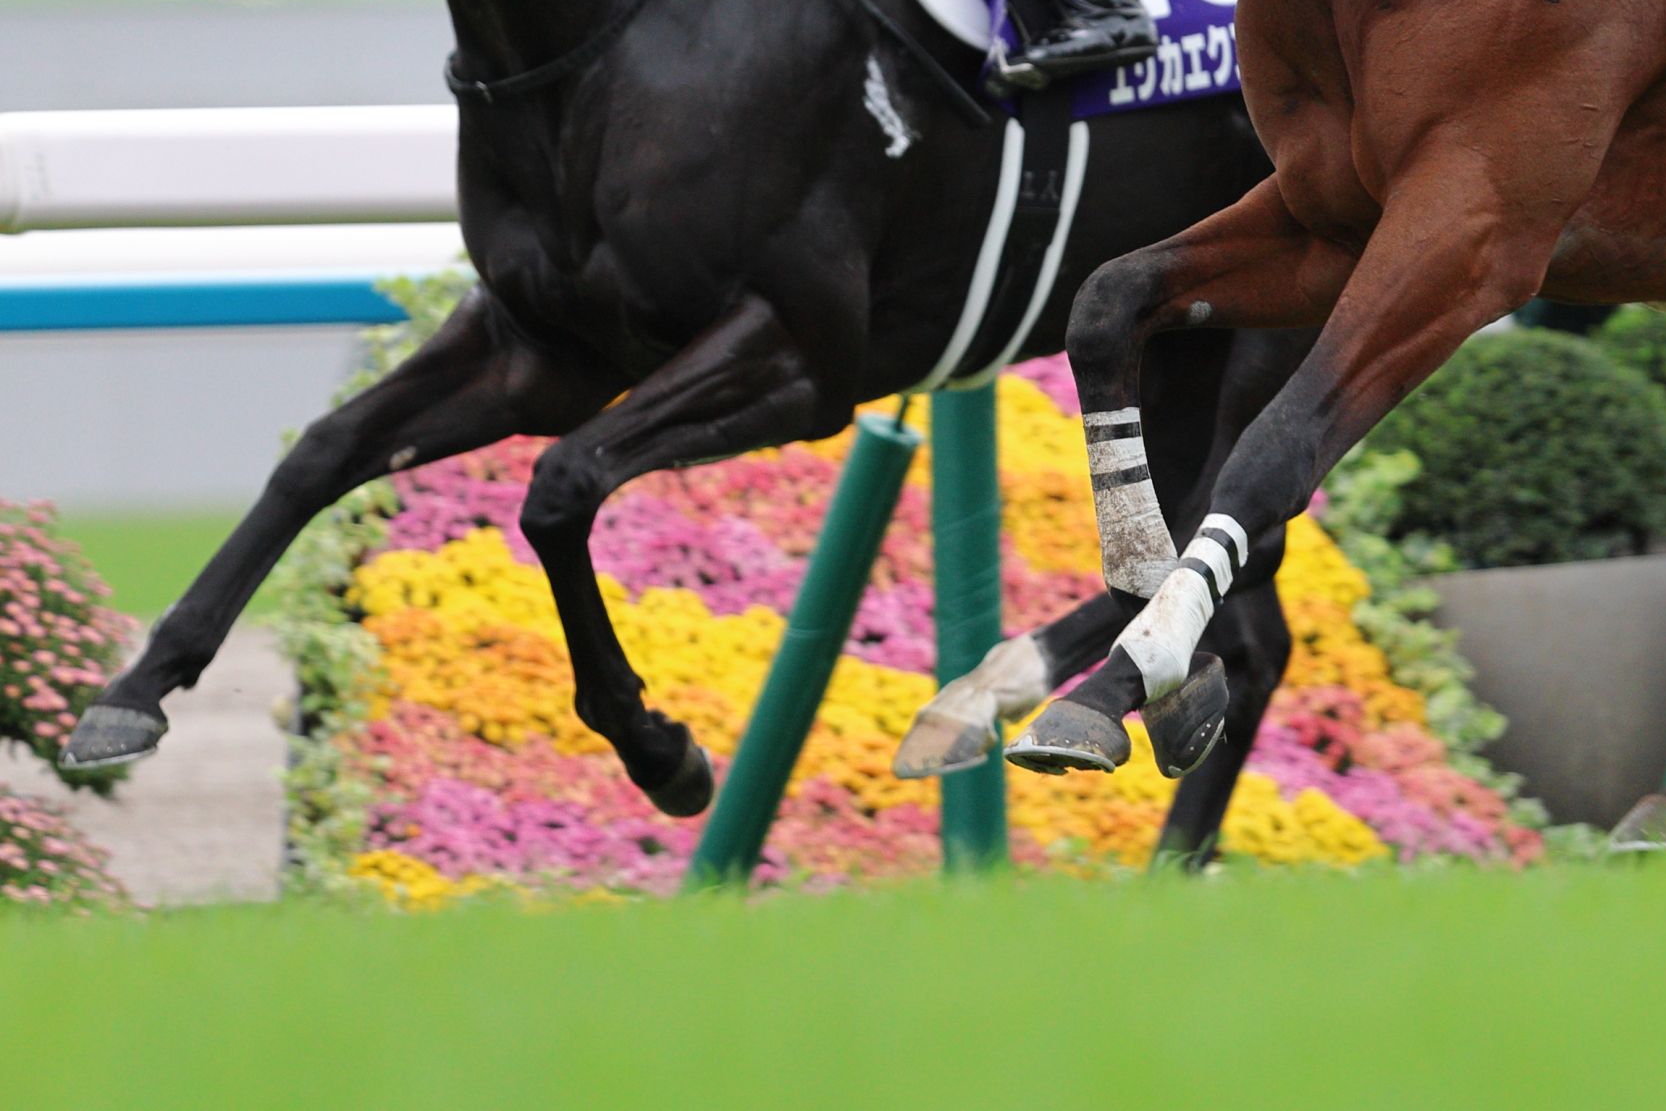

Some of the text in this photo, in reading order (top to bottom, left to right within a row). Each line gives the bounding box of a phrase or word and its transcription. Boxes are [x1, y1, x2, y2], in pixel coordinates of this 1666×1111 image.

[1109, 23, 1241, 105] エリカエク
